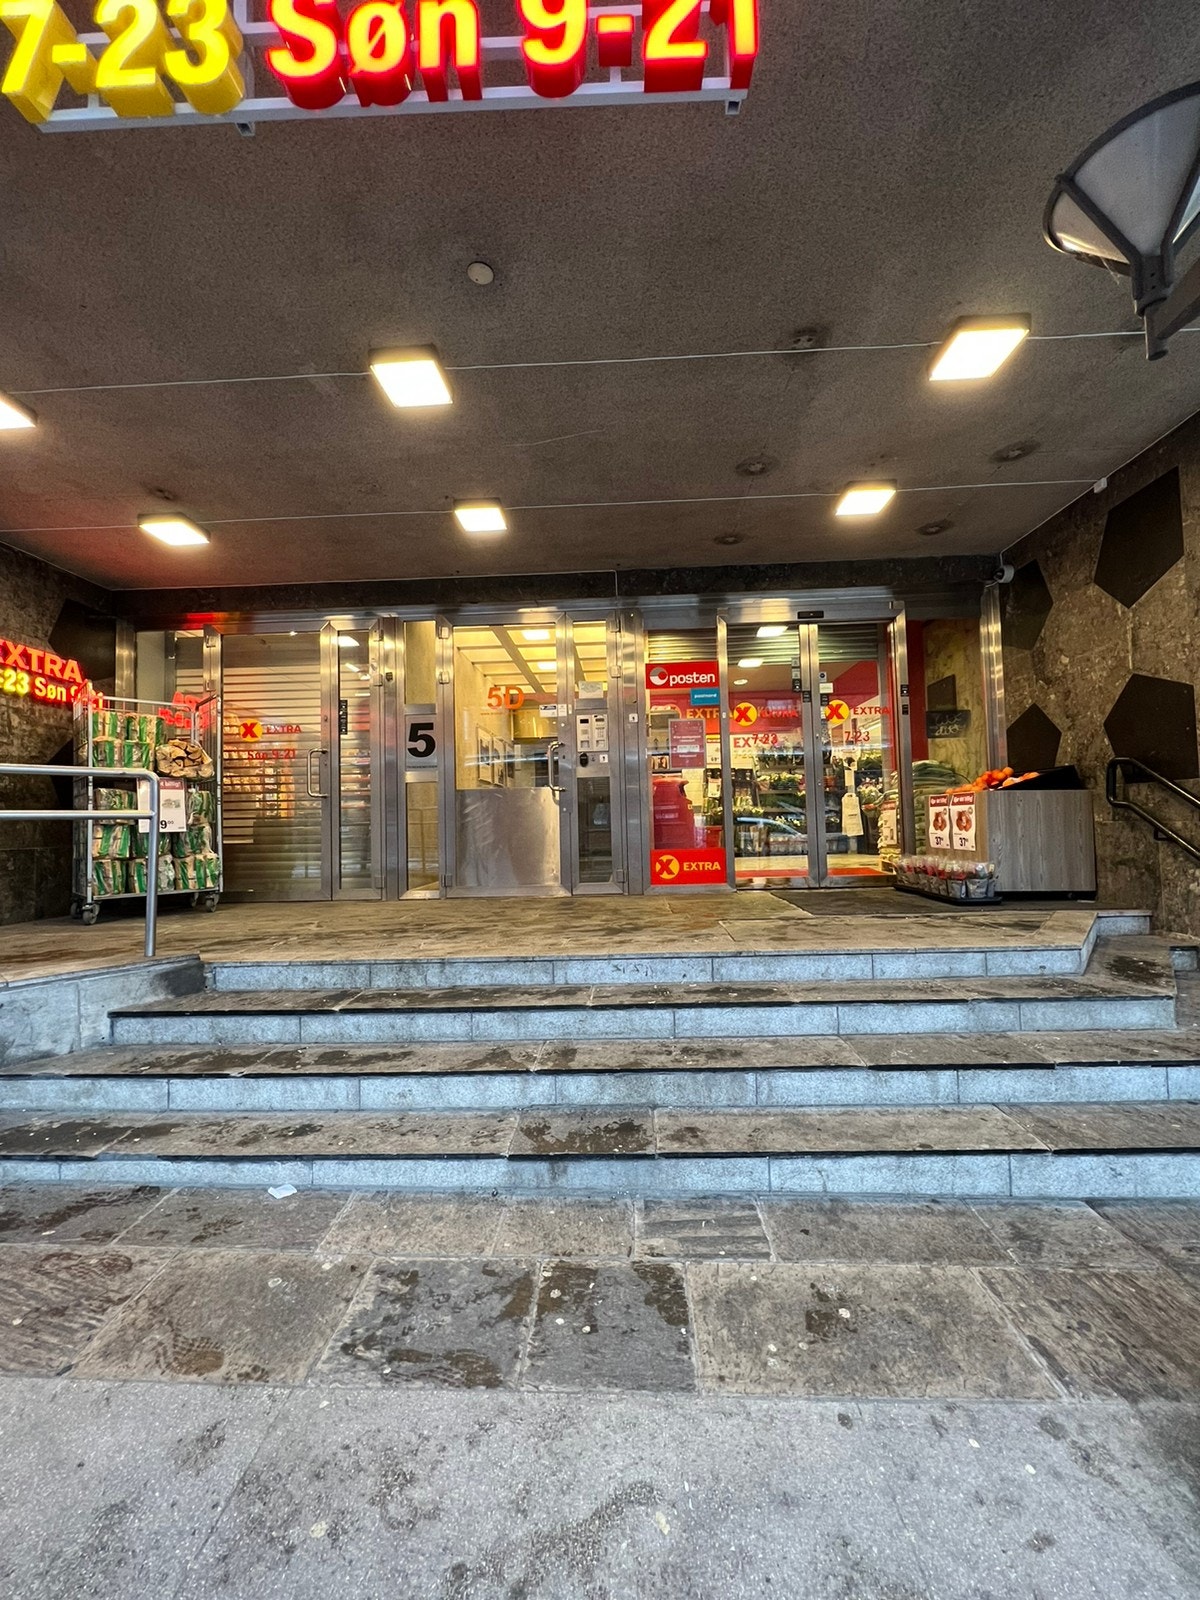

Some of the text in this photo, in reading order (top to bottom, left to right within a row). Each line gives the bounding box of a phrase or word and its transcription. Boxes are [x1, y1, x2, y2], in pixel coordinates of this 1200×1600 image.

[0, 0, 759, 100] 7-23 Søn 9-21
[0, 638, 84, 684] XTRA
[669, 671, 716, 687] posten
[34, 677, 67, 702] Søn
[487, 685, 526, 710] 5D
[853, 706, 891, 716] EXTRA
[266, 724, 302, 734] EXTRA
[844, 731, 870, 743] 7-23
[407, 722, 436, 757] 5
[271, 748, 296, 760] 9-21
[683, 861, 721, 871] EXTRA
